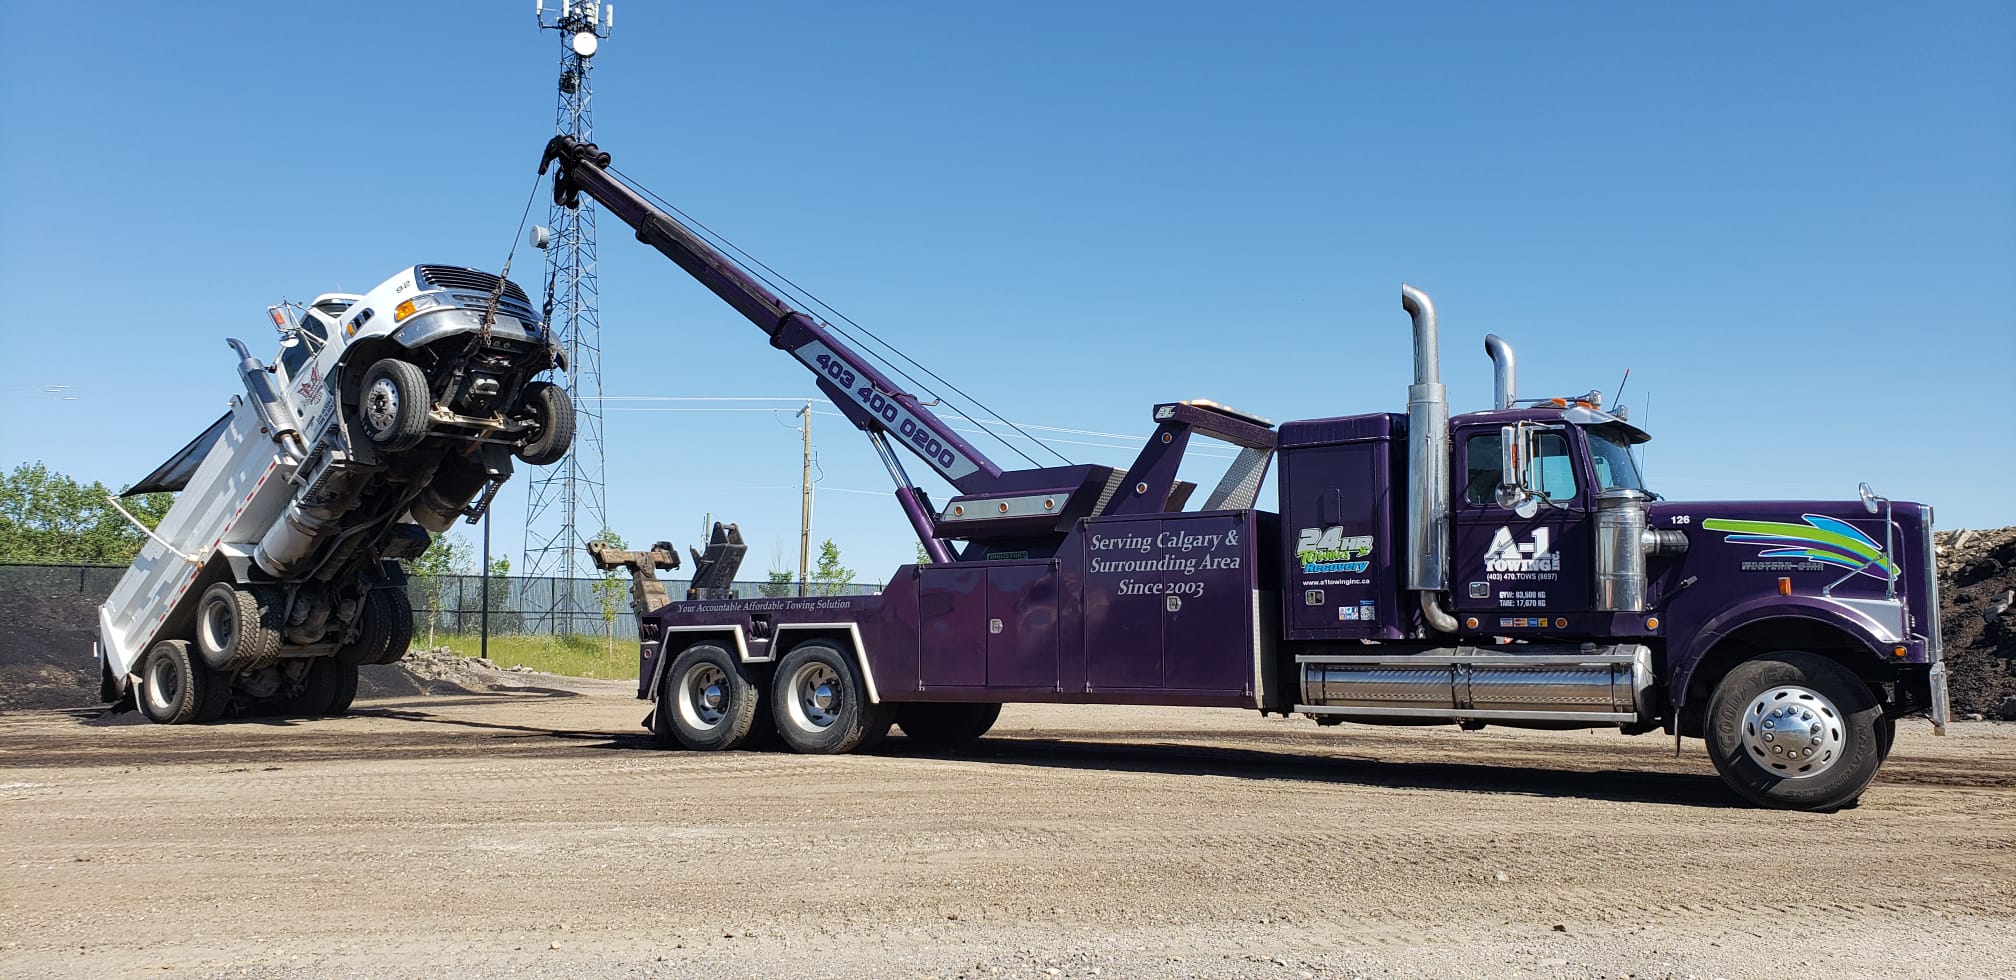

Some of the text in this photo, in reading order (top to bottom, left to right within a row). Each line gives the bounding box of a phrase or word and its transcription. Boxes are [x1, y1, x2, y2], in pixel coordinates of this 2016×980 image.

[396, 281, 411, 292] 92
[816, 354, 955, 469] 403 400 0200
[1670, 515, 1690, 524] 126
[1090, 529, 1238, 553] Serving Calgary &
[1484, 525, 1552, 560] A-1
[1090, 553, 1240, 575] Surrounding Area
[1304, 561, 1370, 573] Recovery
[1485, 559, 1551, 572] TOWING
[1302, 578, 1370, 586] www.a1towinginc.ca
[1487, 573, 1502, 581] (403)
[1538, 573, 1558, 581] (8697)
[1118, 578, 1205, 598] Since 2003
[678, 599, 851, 613] Your Accountable Affordable Towing Solution
